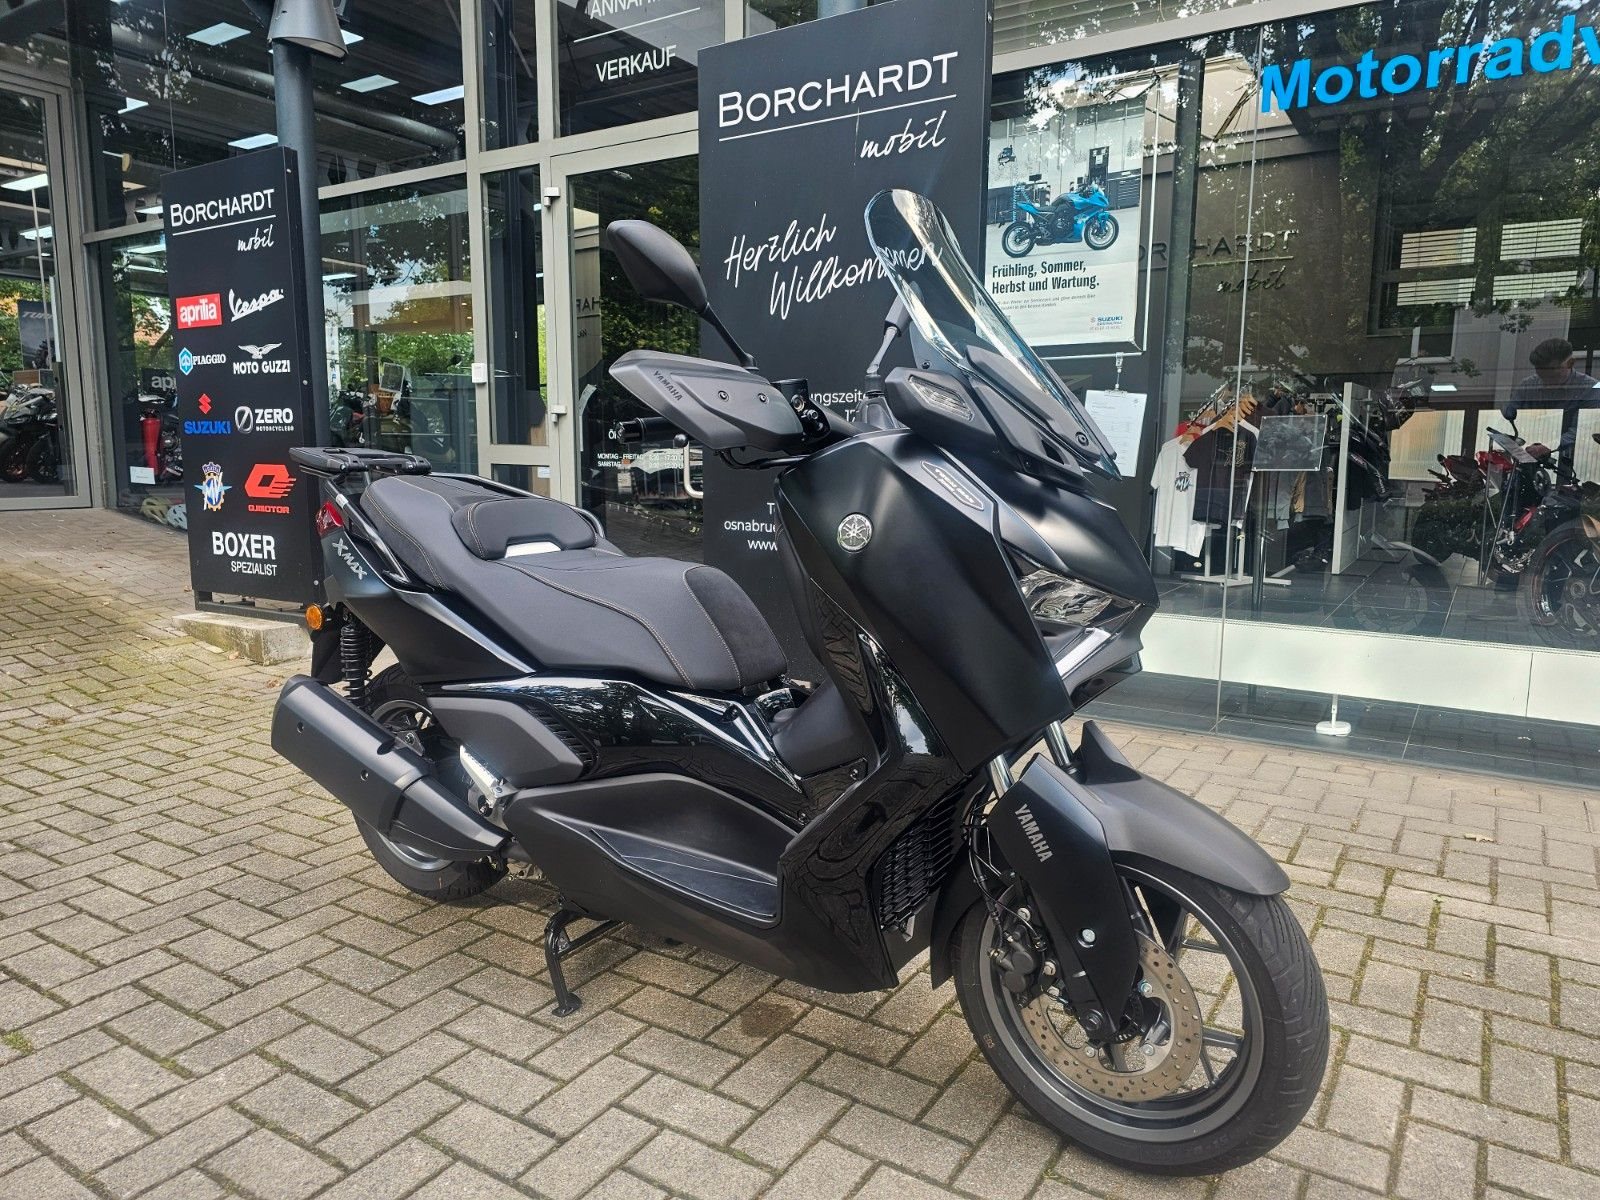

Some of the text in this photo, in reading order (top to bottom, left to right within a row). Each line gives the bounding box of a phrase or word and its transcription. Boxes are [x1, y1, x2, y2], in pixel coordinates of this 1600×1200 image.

[595, 44, 677, 82] VERKAUF
[719, 51, 958, 128] BORCHARDT
[860, 110, 947, 158] mobil
[170, 188, 275, 227] BORCHARDT
[237, 223, 275, 251] mobil
[724, 213, 837, 288] Herzlich
[992, 260, 1086, 279] Frühling, Sommer,
[992, 274, 1100, 295] Herbst und Wartung.
[180, 298, 217, 326] aprilia
[228, 289, 284, 322] Vespa
[193, 354, 227, 366] PIAGGIO
[233, 359, 291, 375] MOTO GUZZI
[653, 370, 683, 401] YAMAHA
[183, 420, 231, 435] SUZUKI
[255, 407, 294, 424] ZERO
[212, 531, 276, 560] BOXER
[230, 560, 278, 577] SPEZIALIST
[1014, 803, 1053, 863] YAMAHA
